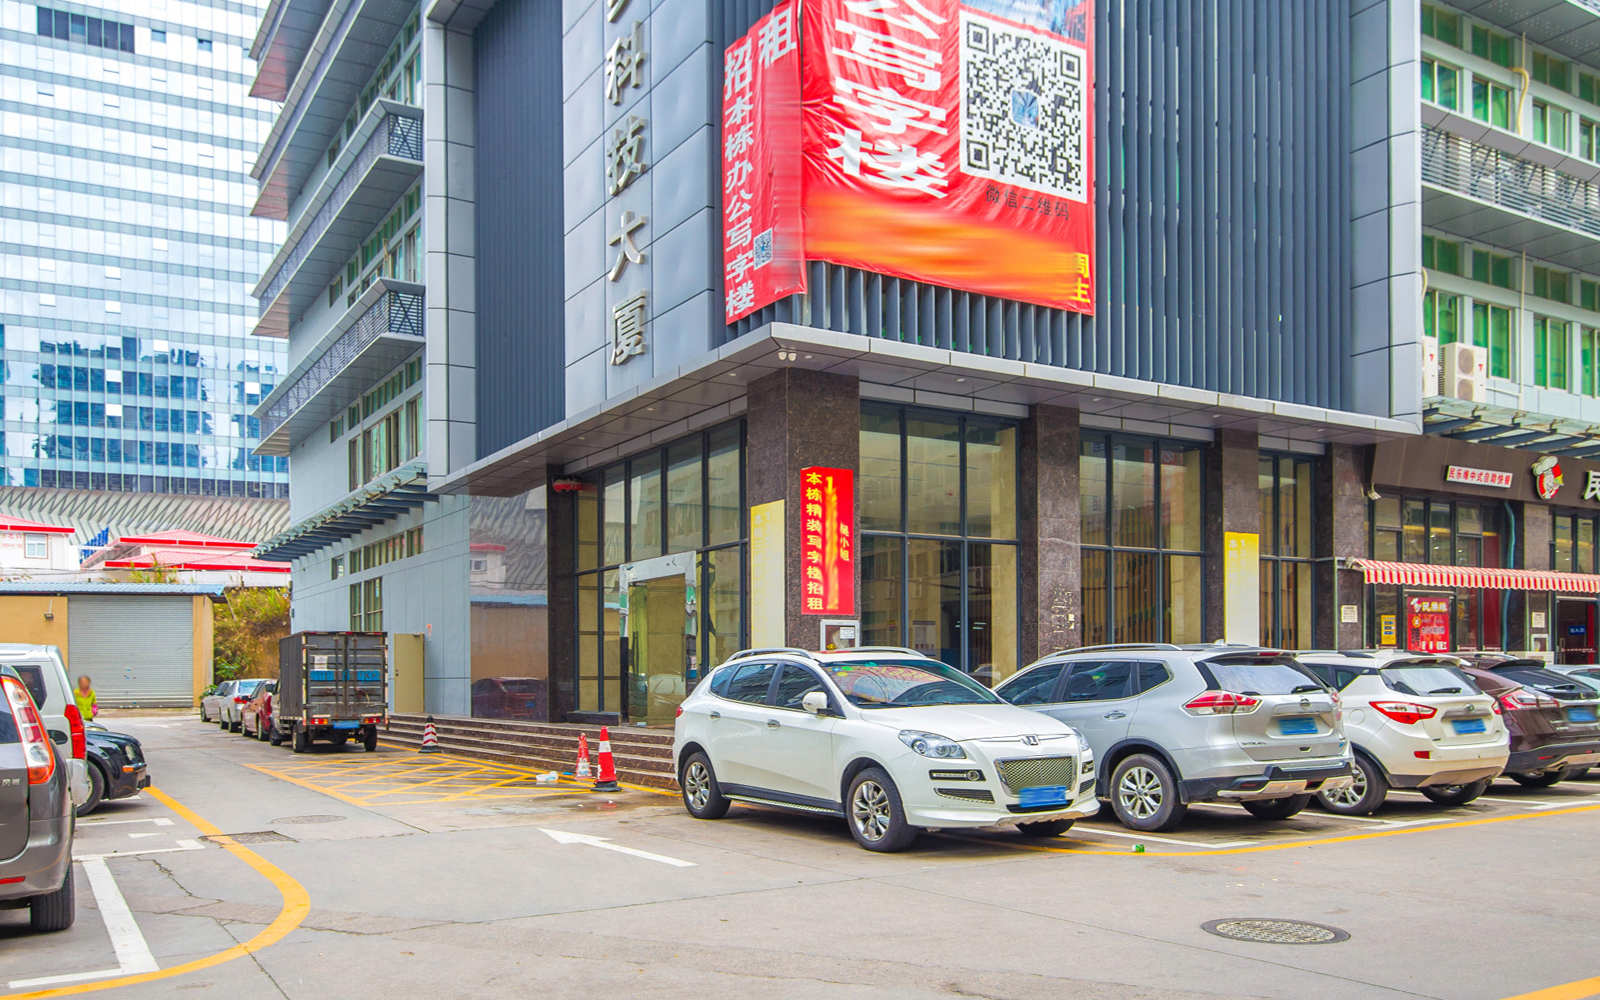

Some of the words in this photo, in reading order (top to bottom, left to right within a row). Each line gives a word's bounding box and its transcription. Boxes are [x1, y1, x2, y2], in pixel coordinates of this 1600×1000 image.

[725, 91, 755, 318] 本栋办公写字楼
[985, 184, 1069, 220] 微信二维码
[806, 472, 824, 610] 本栋精装写字楼招租
